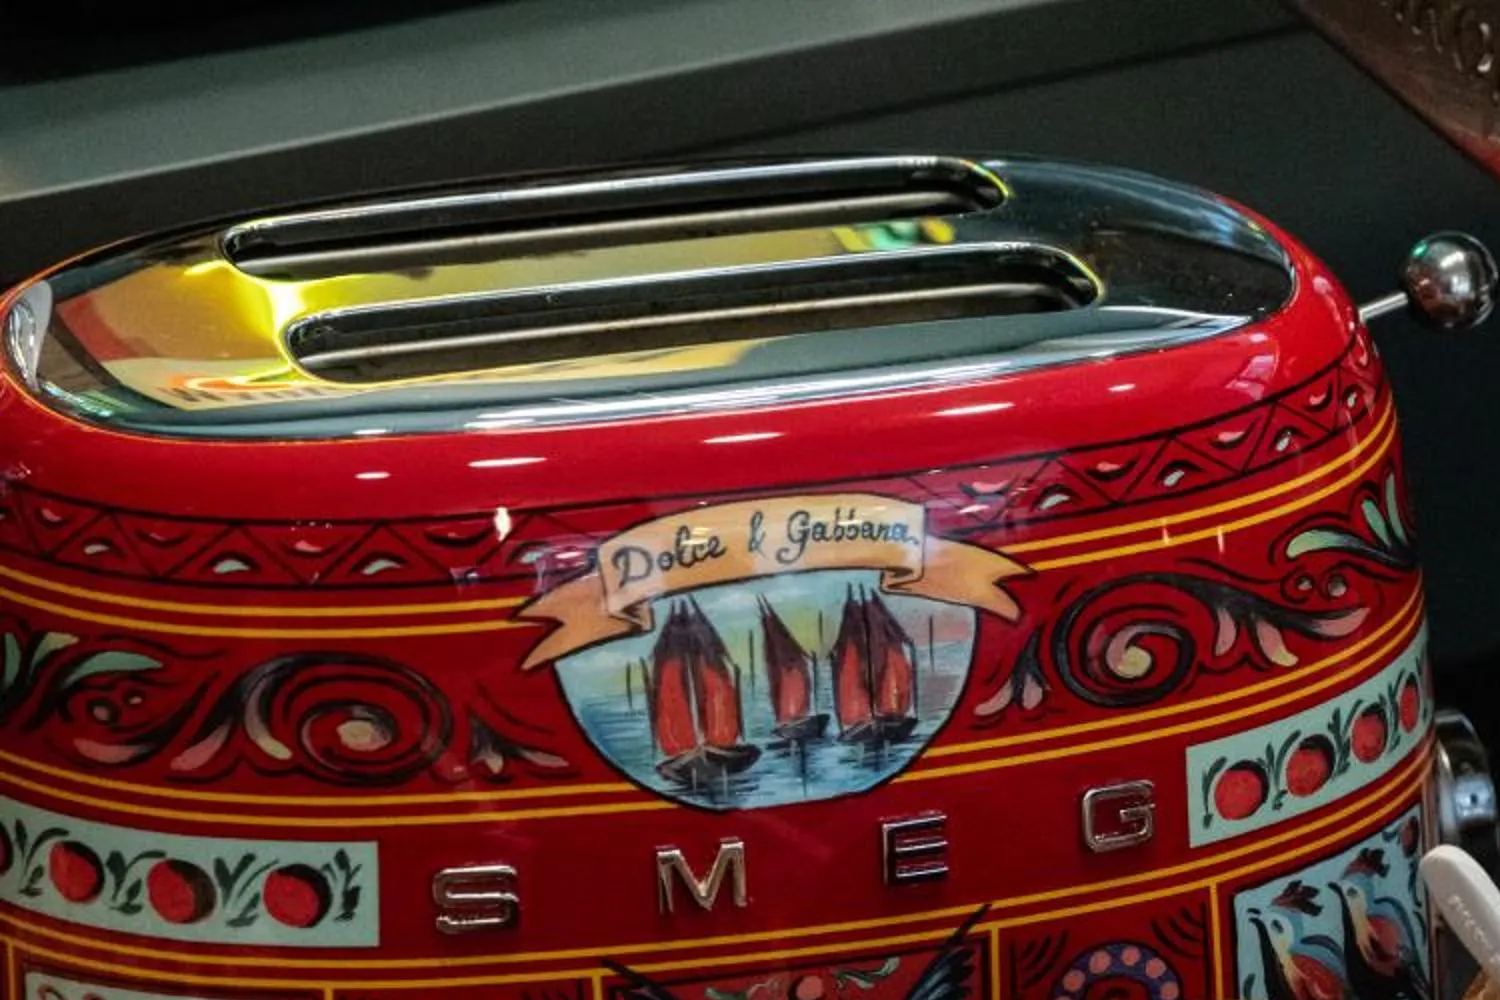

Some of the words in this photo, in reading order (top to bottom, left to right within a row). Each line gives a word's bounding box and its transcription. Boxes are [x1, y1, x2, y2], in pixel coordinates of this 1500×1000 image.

[612, 525, 727, 587] Dolce
[776, 506, 919, 564] Gabbana
[432, 779, 1156, 935] SMEG
